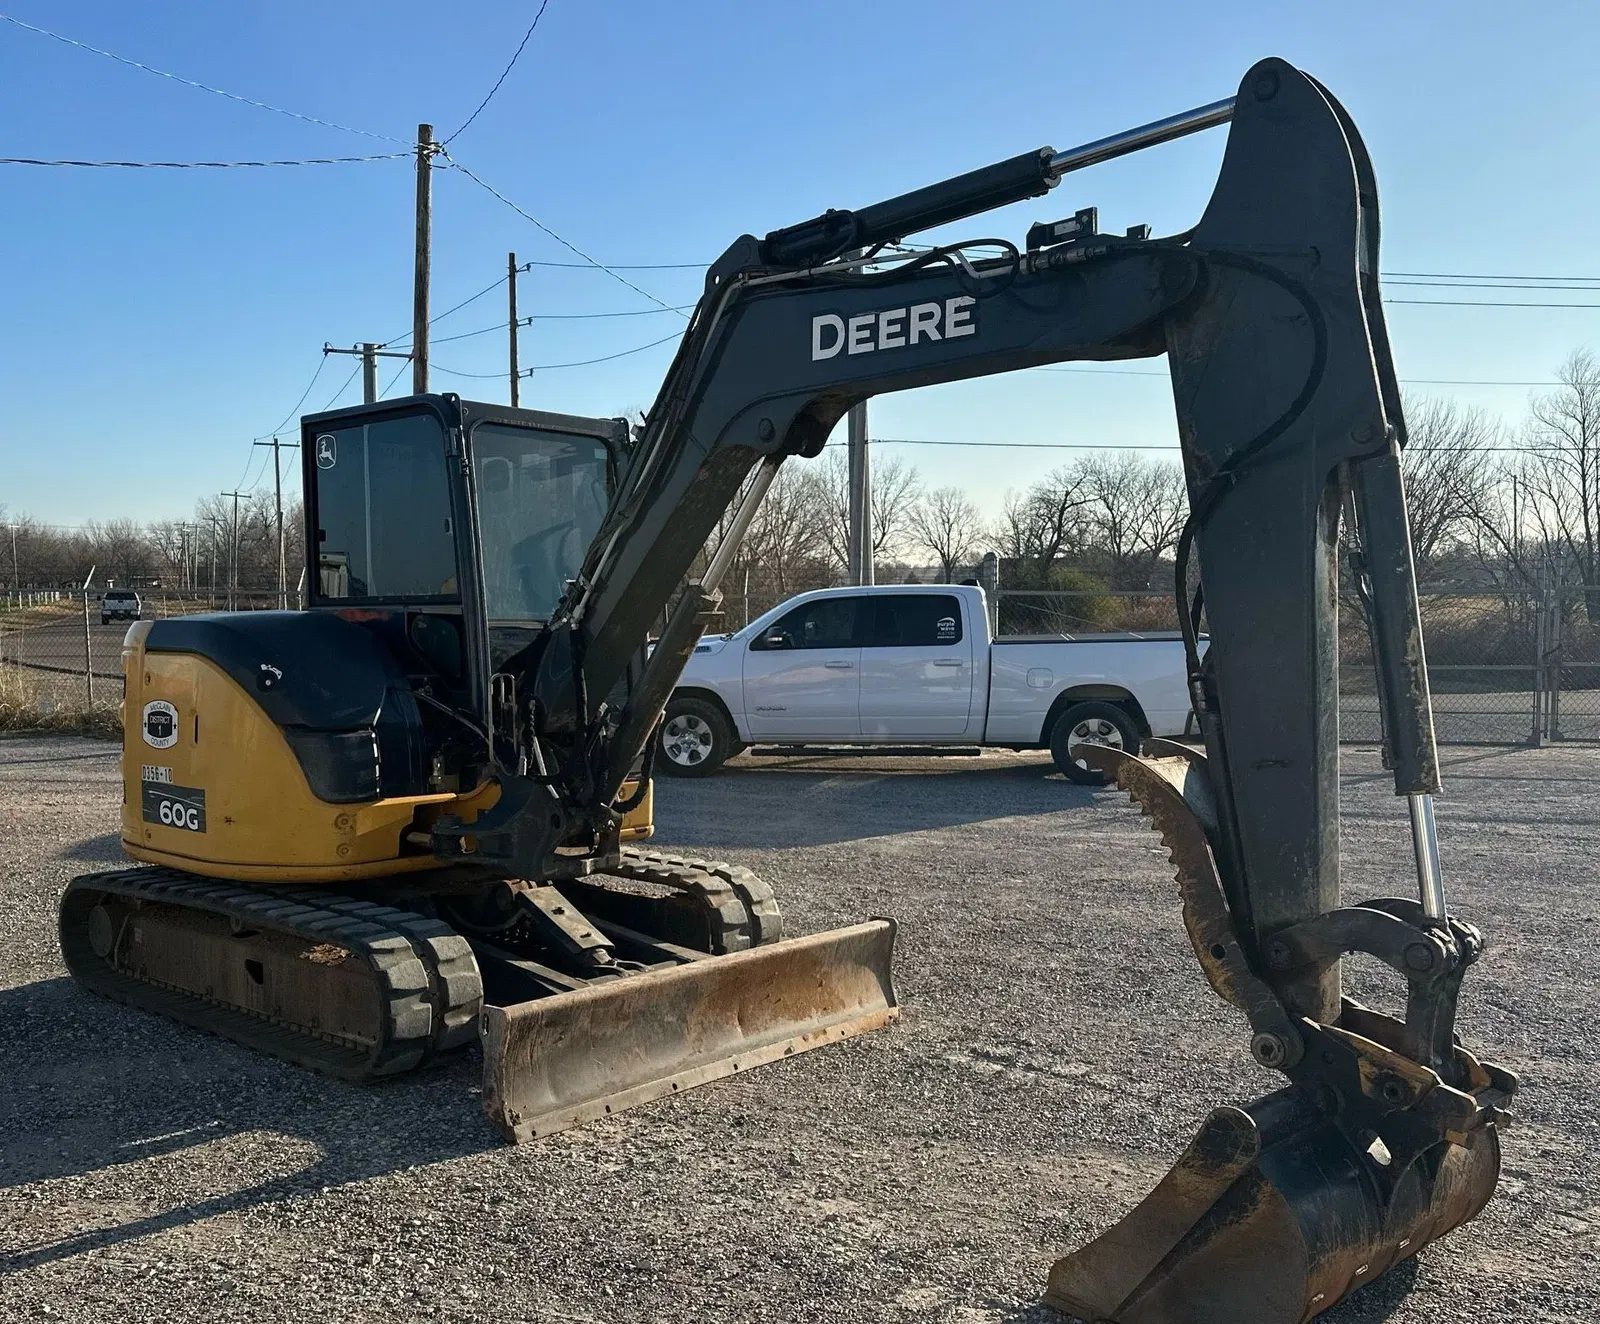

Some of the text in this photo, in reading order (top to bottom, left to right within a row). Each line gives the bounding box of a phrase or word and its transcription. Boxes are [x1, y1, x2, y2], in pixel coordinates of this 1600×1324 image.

[812, 295, 976, 361] DEERE
[150, 715, 171, 724] DISTRICT
[158, 724, 162, 736] 1
[150, 737, 170, 747] COUNTY
[159, 800, 199, 830] 60G
